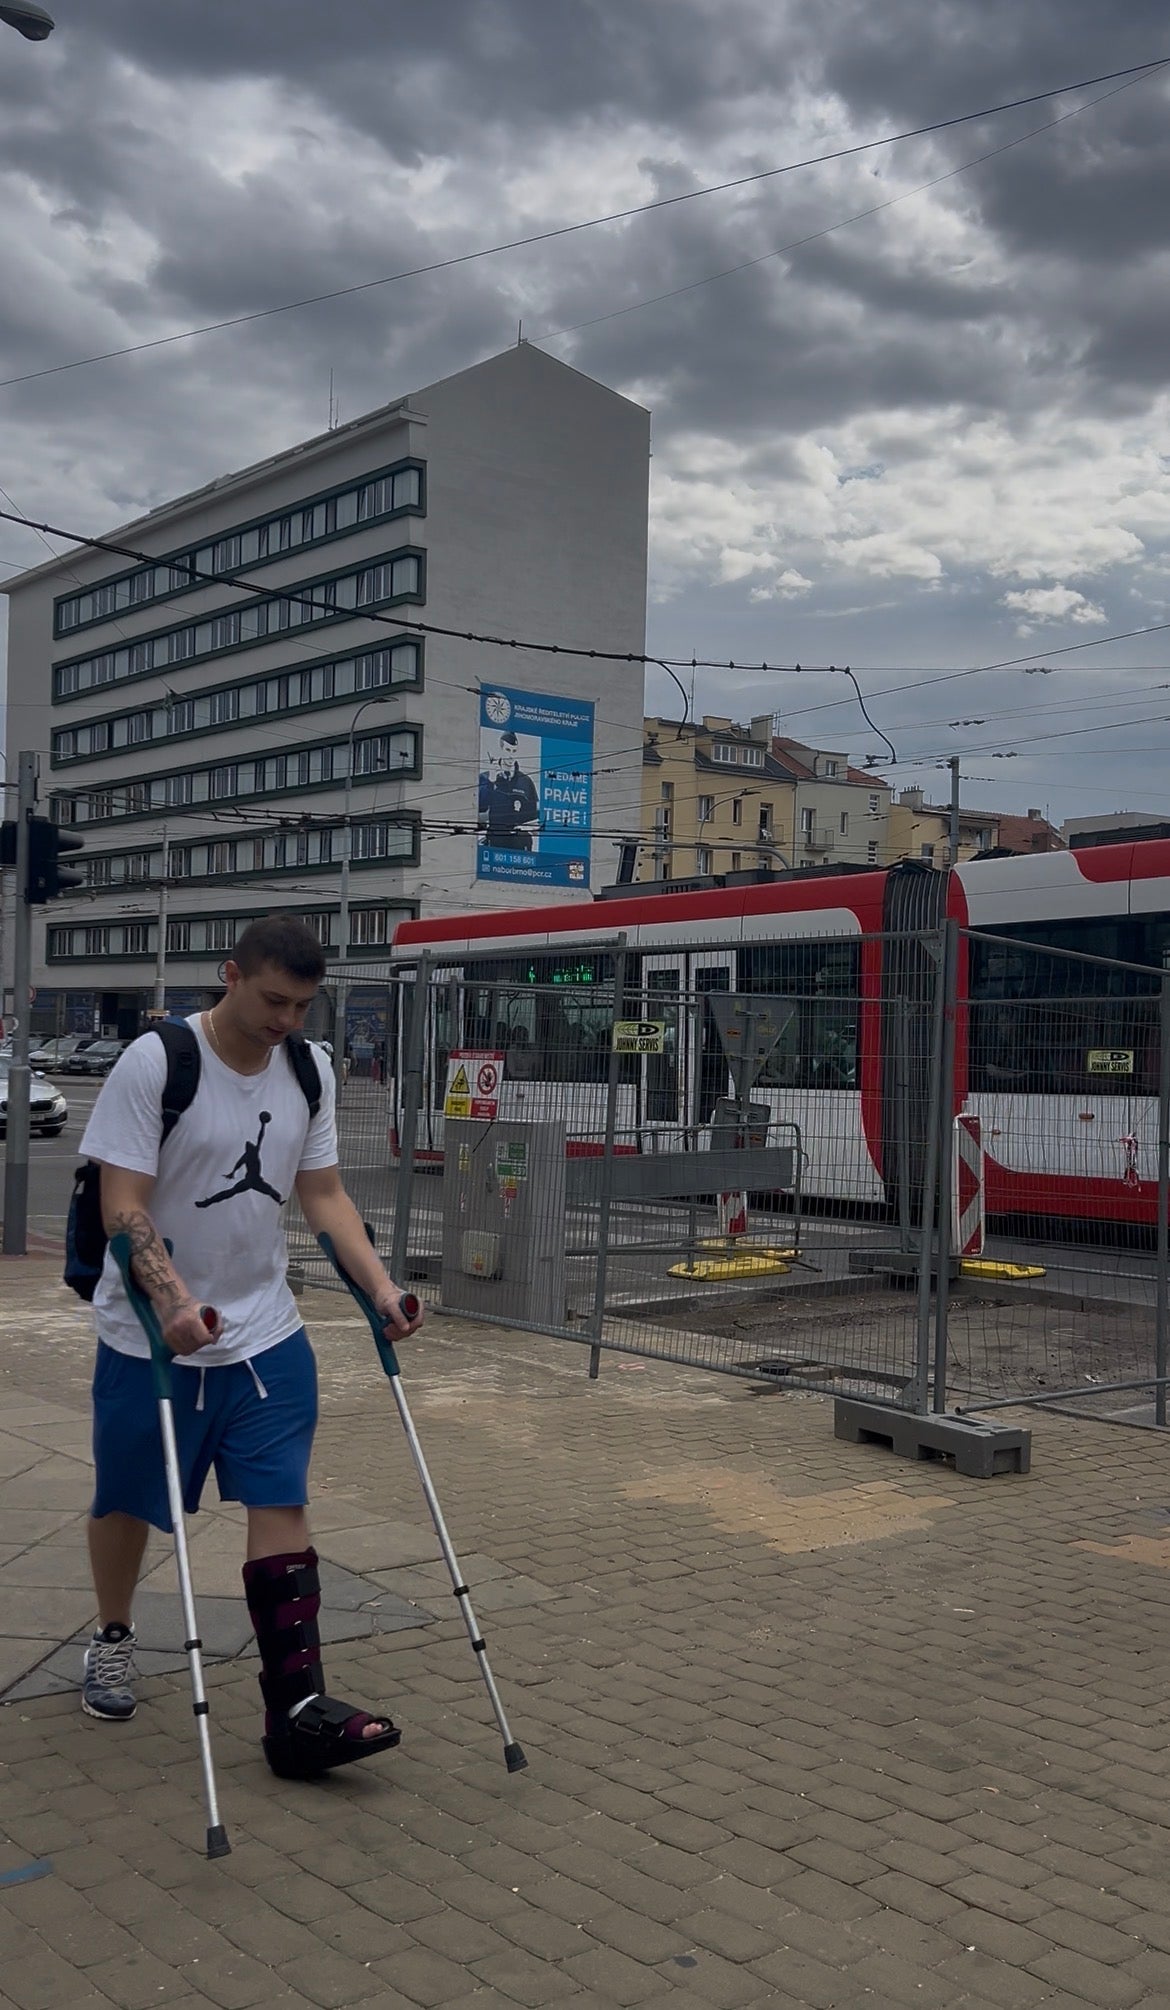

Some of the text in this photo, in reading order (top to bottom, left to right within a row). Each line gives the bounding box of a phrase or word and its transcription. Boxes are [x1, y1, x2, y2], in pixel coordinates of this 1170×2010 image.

[544, 786, 588, 805] PRÁVĚ
[616, 1037, 659, 1051] JOHNNY SERVIS
[1091, 1062, 1130, 1072] JOHNNY SERVIS
